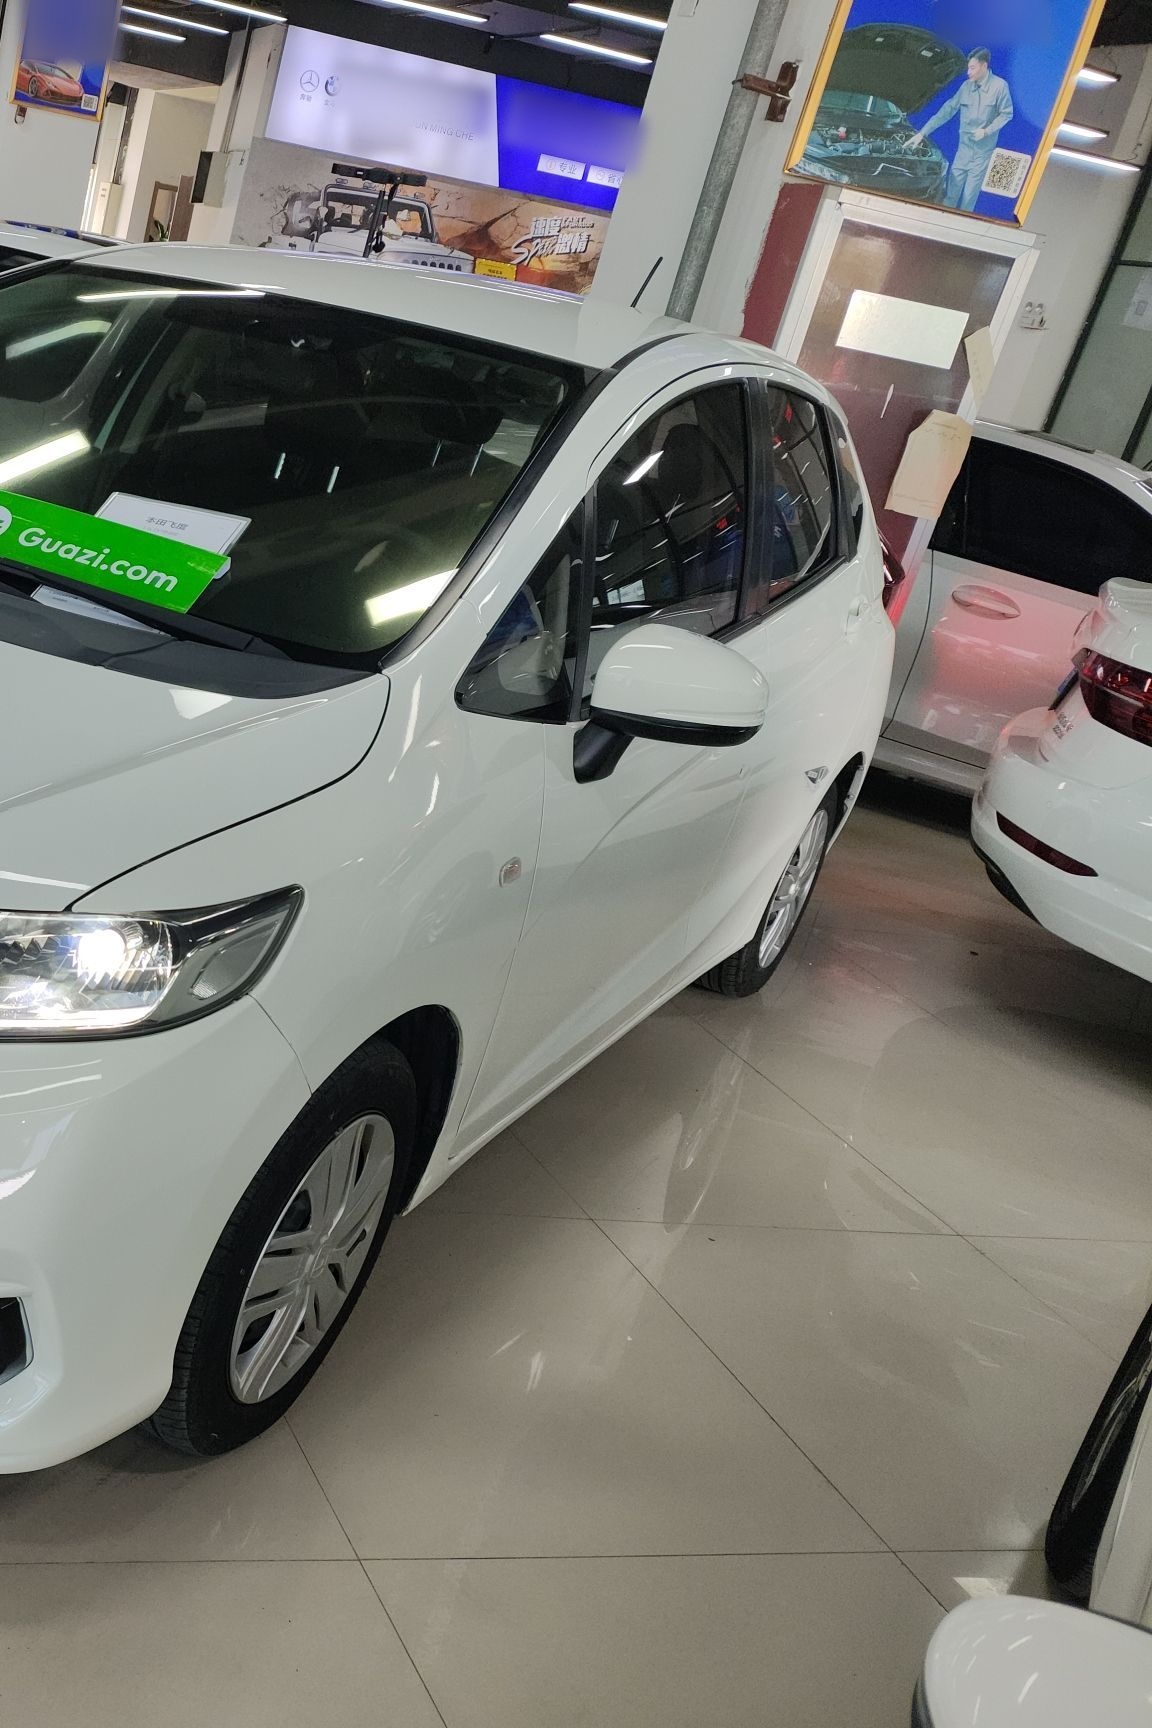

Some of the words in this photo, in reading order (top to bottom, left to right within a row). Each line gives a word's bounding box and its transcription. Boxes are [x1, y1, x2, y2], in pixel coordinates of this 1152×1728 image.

[429, 123, 454, 137] MING
[455, 129, 475, 141] CHE
[559, 161, 577, 175] 专业
[17, 526, 179, 593] Guazi.com
